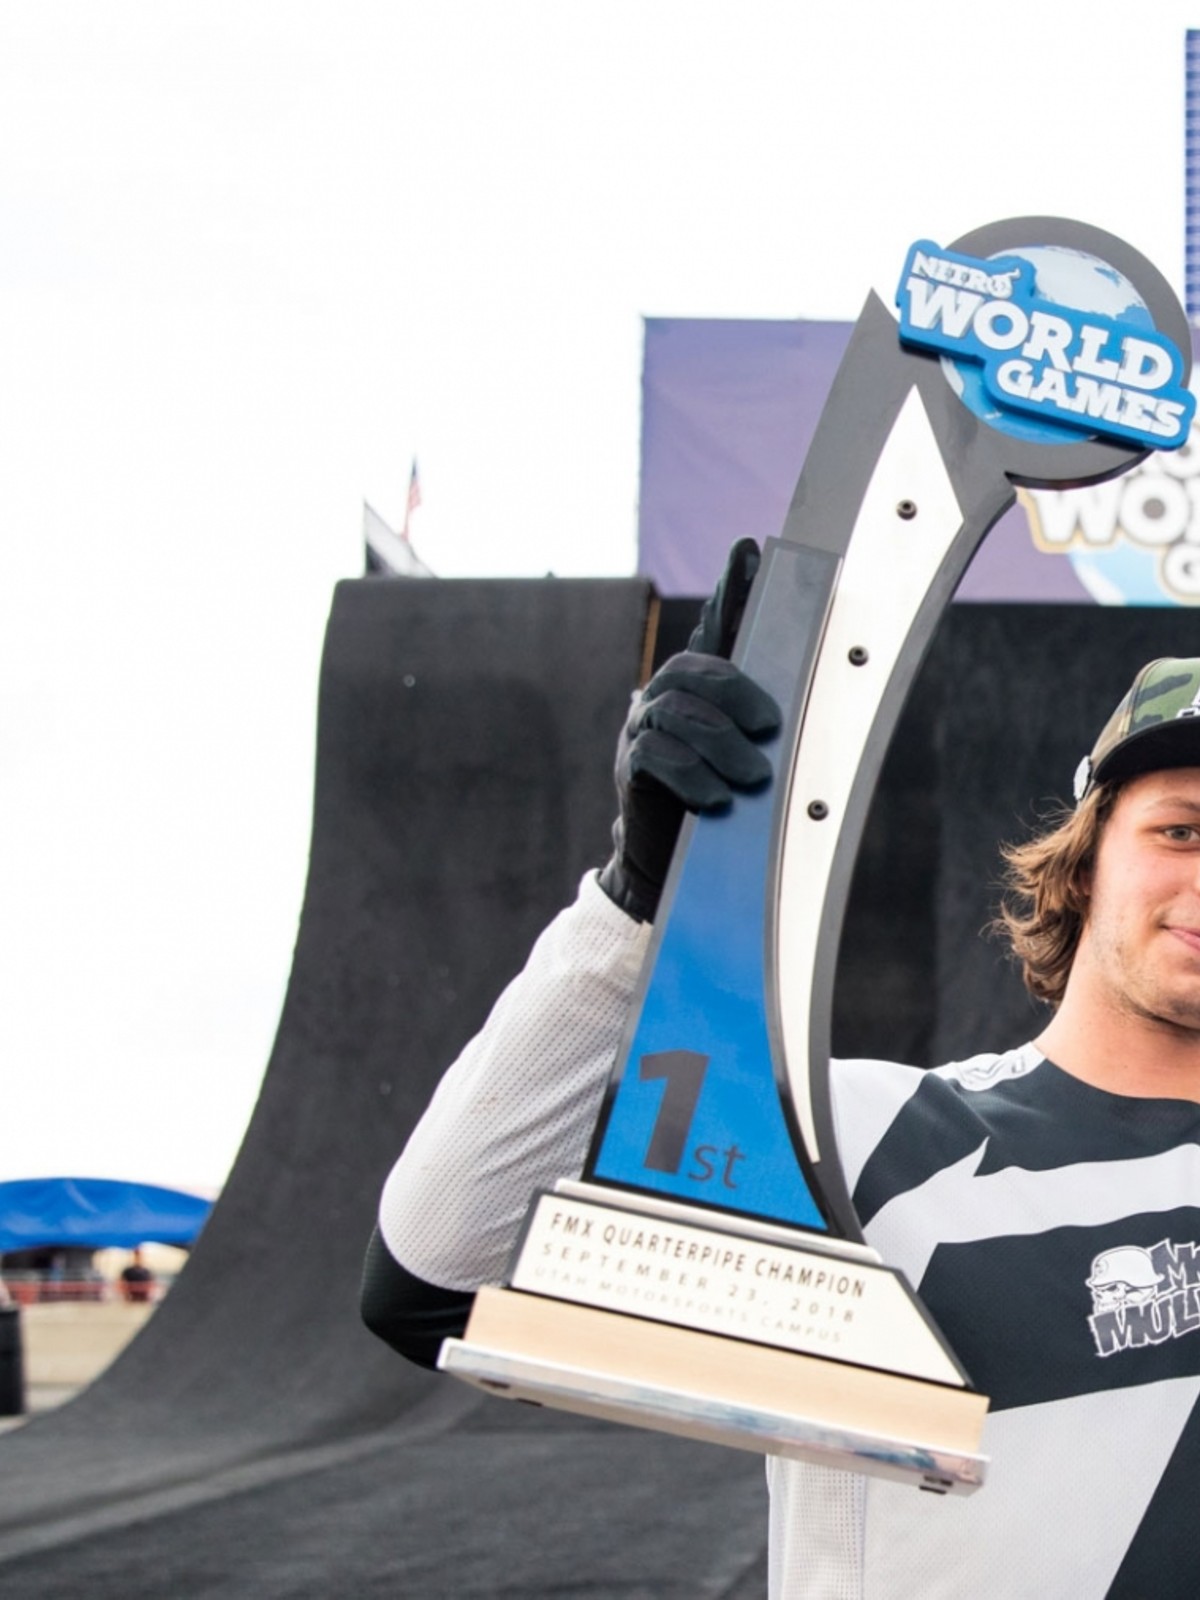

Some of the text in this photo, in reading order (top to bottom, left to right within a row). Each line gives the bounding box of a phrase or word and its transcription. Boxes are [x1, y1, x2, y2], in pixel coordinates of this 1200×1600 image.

[911, 250, 1021, 299] NITRO
[906, 276, 1174, 390] WORLD
[996, 359, 1185, 438] GAMES
[639, 1049, 746, 1190] 1st
[542, 1242, 856, 1324] SEPTEMBER 23, 2018
[550, 1212, 867, 1299] FMX QUARTERPIPE CHAMPION
[533, 1265, 842, 1344] UTAH MOTORSPORTS CAMPUS
